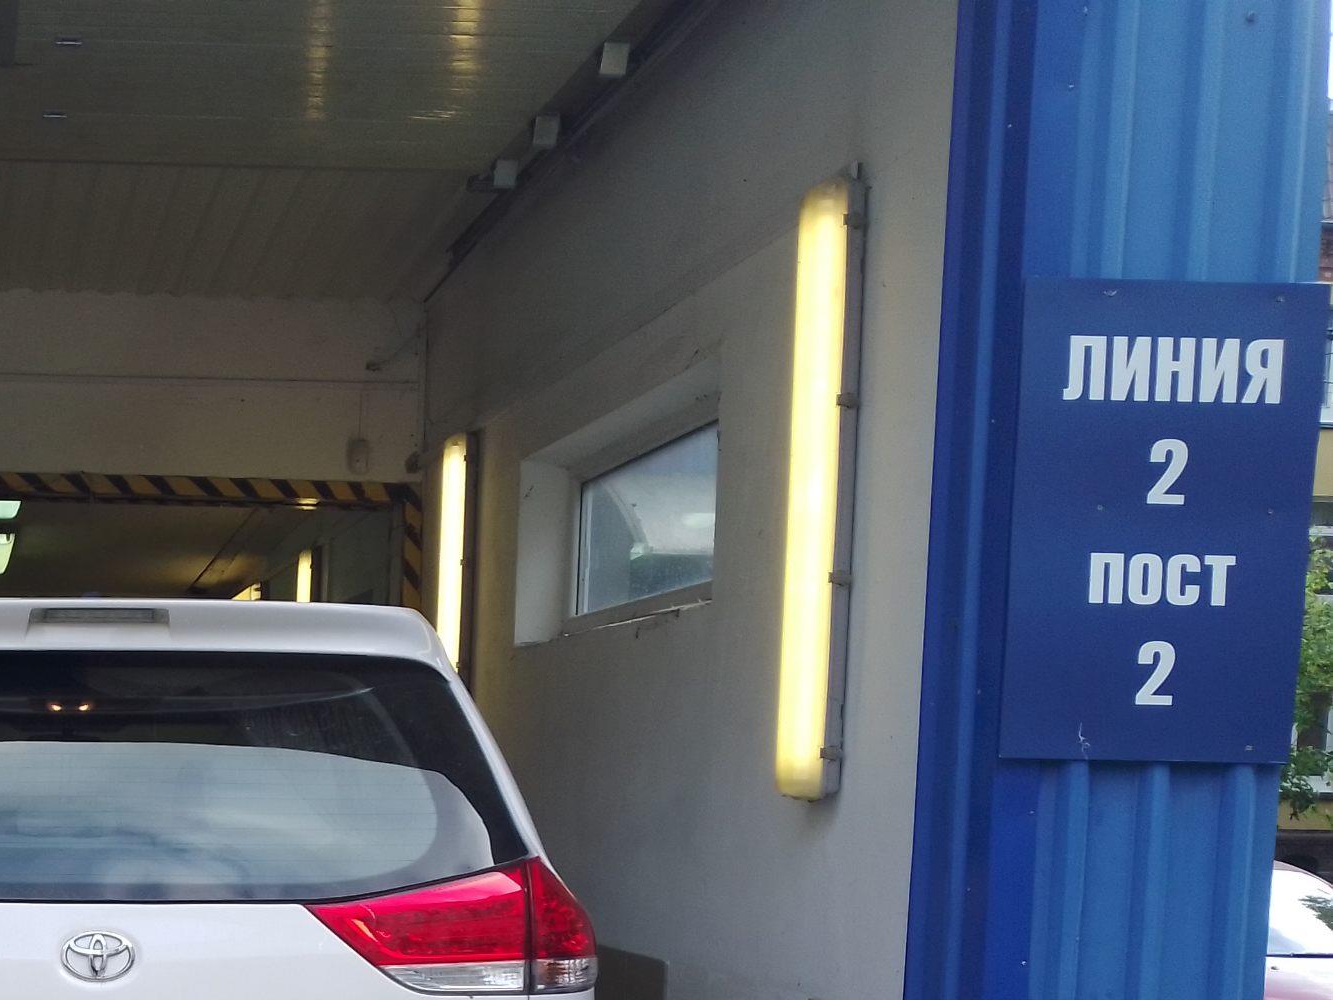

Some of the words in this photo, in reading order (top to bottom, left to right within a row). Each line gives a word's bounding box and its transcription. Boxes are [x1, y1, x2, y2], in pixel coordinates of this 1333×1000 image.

[1063, 335, 1285, 404] ЛИНИЯ
[1146, 438, 1189, 505] 2
[1088, 552, 1237, 606] ПОСТ
[1134, 640, 1176, 706] 2
